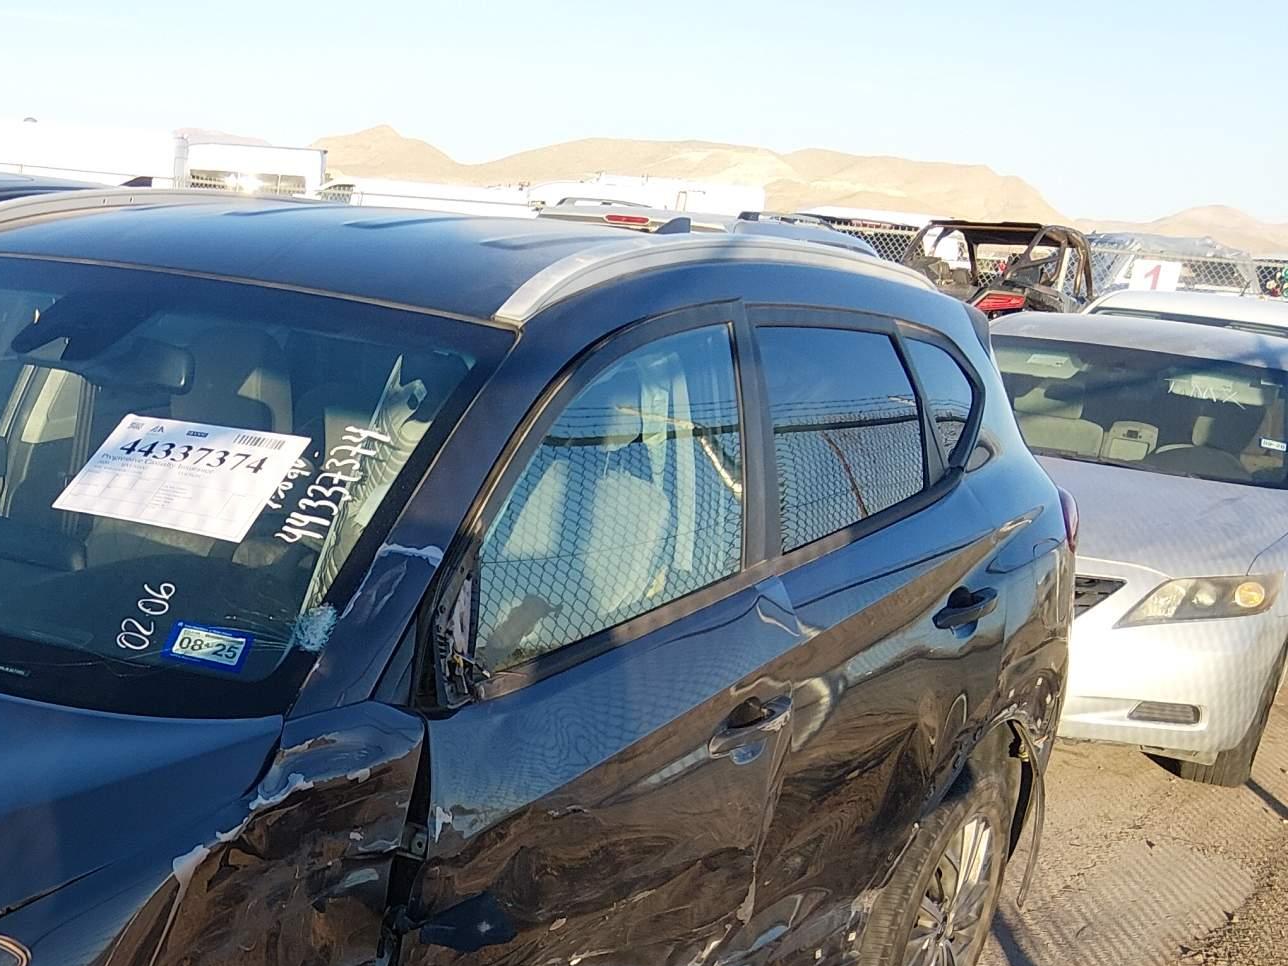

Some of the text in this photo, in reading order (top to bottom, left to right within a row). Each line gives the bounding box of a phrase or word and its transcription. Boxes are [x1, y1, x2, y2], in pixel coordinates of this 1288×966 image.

[1144, 264, 1161, 290] 1
[120, 438, 269, 474] 44337374
[274, 426, 391, 543] 44337374
[179, 636, 204, 652] 08
[212, 643, 241, 660] 25
